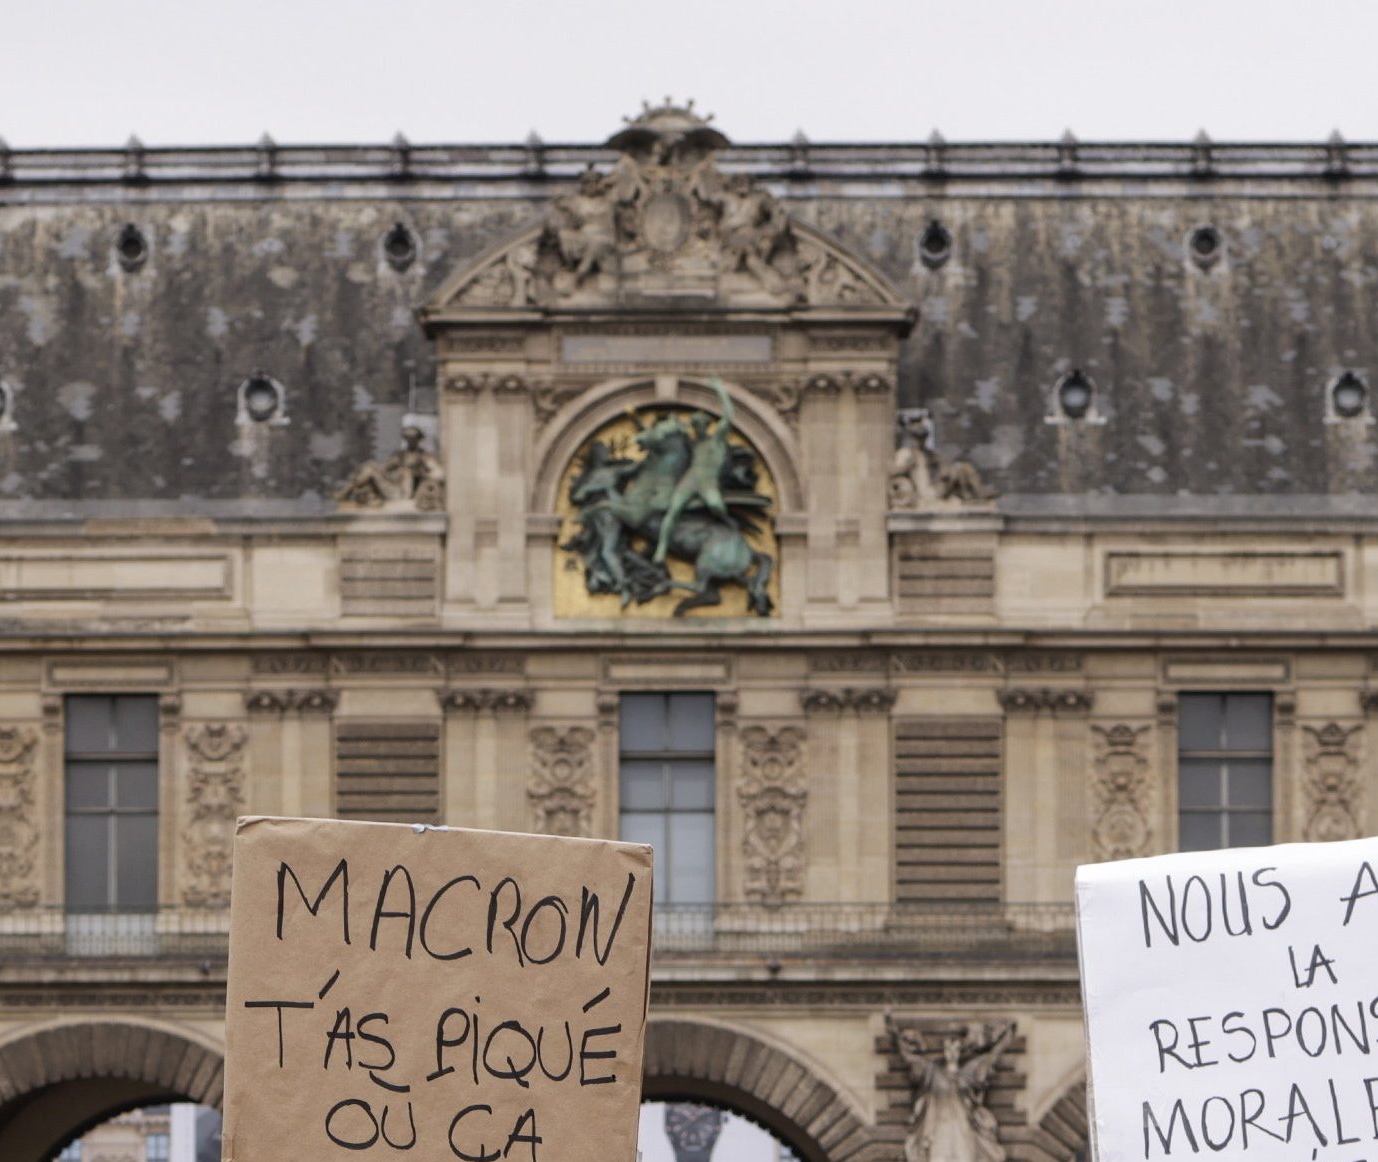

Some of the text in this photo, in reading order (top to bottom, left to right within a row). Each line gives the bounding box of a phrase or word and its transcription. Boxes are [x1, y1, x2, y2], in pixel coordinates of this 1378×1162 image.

[277, 857, 636, 967] MACRON
[1140, 867, 1291, 948] NOUS
[1289, 943, 1338, 989] LA
[326, 1098, 416, 1150] OU
